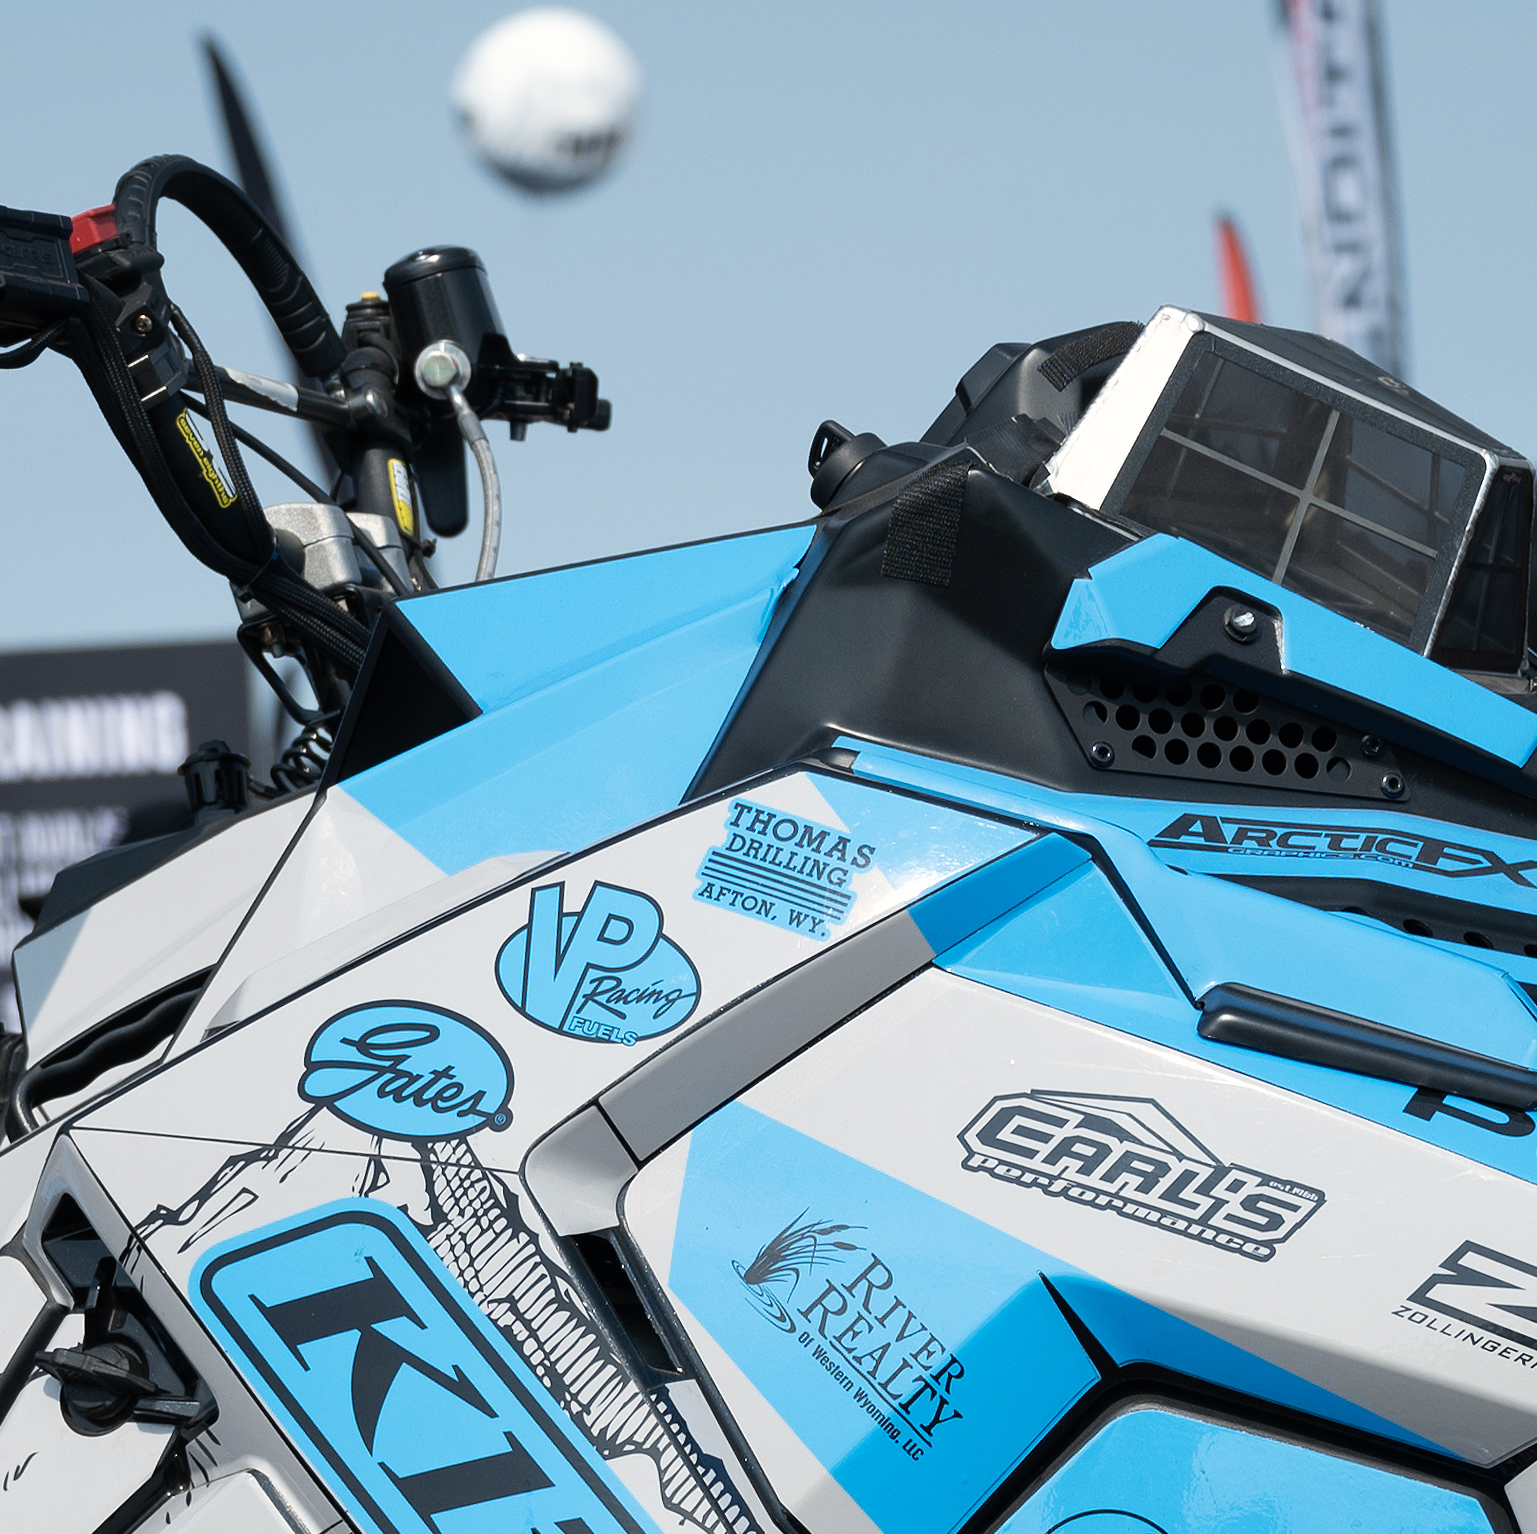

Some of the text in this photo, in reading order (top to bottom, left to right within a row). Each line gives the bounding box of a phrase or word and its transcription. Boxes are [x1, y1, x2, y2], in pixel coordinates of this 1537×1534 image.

[725, 833, 849, 888] DRILLING
[730, 803, 876, 869] THOMAS
[520, 880, 664, 1032] VP
[698, 882, 826, 937] AFTON, WY.
[568, 1016, 639, 1046] FUELS
[575, 975, 697, 1020] Racing
[311, 1021, 493, 1119] Gates
[960, 1098, 1323, 1242] CARL'S
[962, 1153, 1276, 1262] performance
[797, 1279, 963, 1437] REALTY
[841, 1253, 965, 1395] RIVER
[798, 1331, 814, 1348] Of
[812, 1345, 854, 1392] Western
[902, 1438, 924, 1460] LLC
